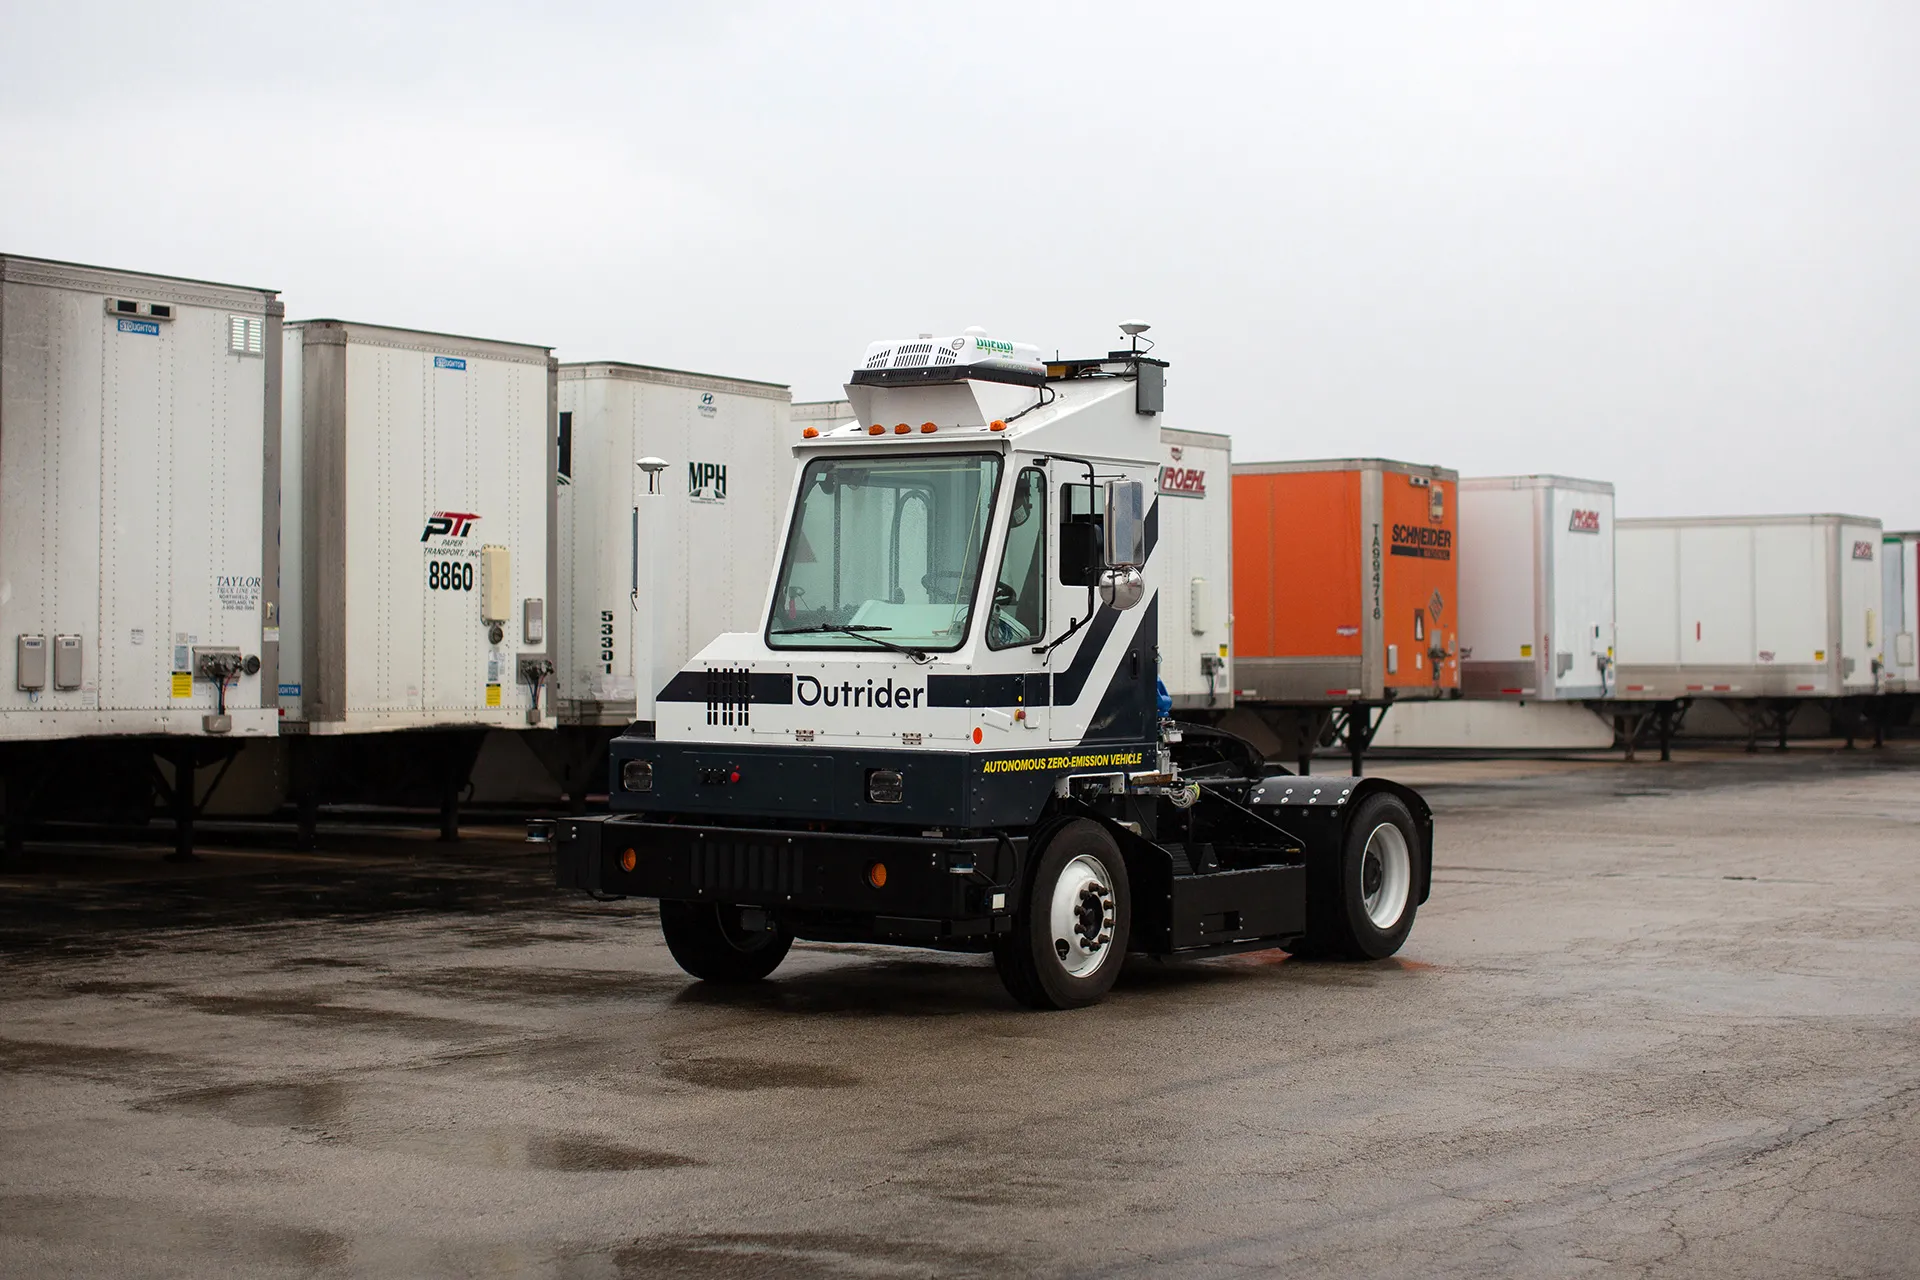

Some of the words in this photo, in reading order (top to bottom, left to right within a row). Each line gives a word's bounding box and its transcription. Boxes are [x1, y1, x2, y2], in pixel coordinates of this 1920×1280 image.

[120, 320, 158, 333] STOUGHTON
[689, 461, 726, 496] MPH
[1162, 467, 1205, 492] ROEHL
[1391, 524, 1451, 549] SCHNEIDER
[216, 576, 261, 587] TAYLOR
[429, 561, 473, 591] 8860
[1372, 523, 1380, 620] TA994718
[601, 610, 613, 674] 53301
[796, 675, 924, 708] Outrider
[983, 758, 1046, 773] AUTONOMOUS
[1047, 754, 1108, 769] ZERO-EMISSION
[1110, 753, 1143, 766] VEHICLE
